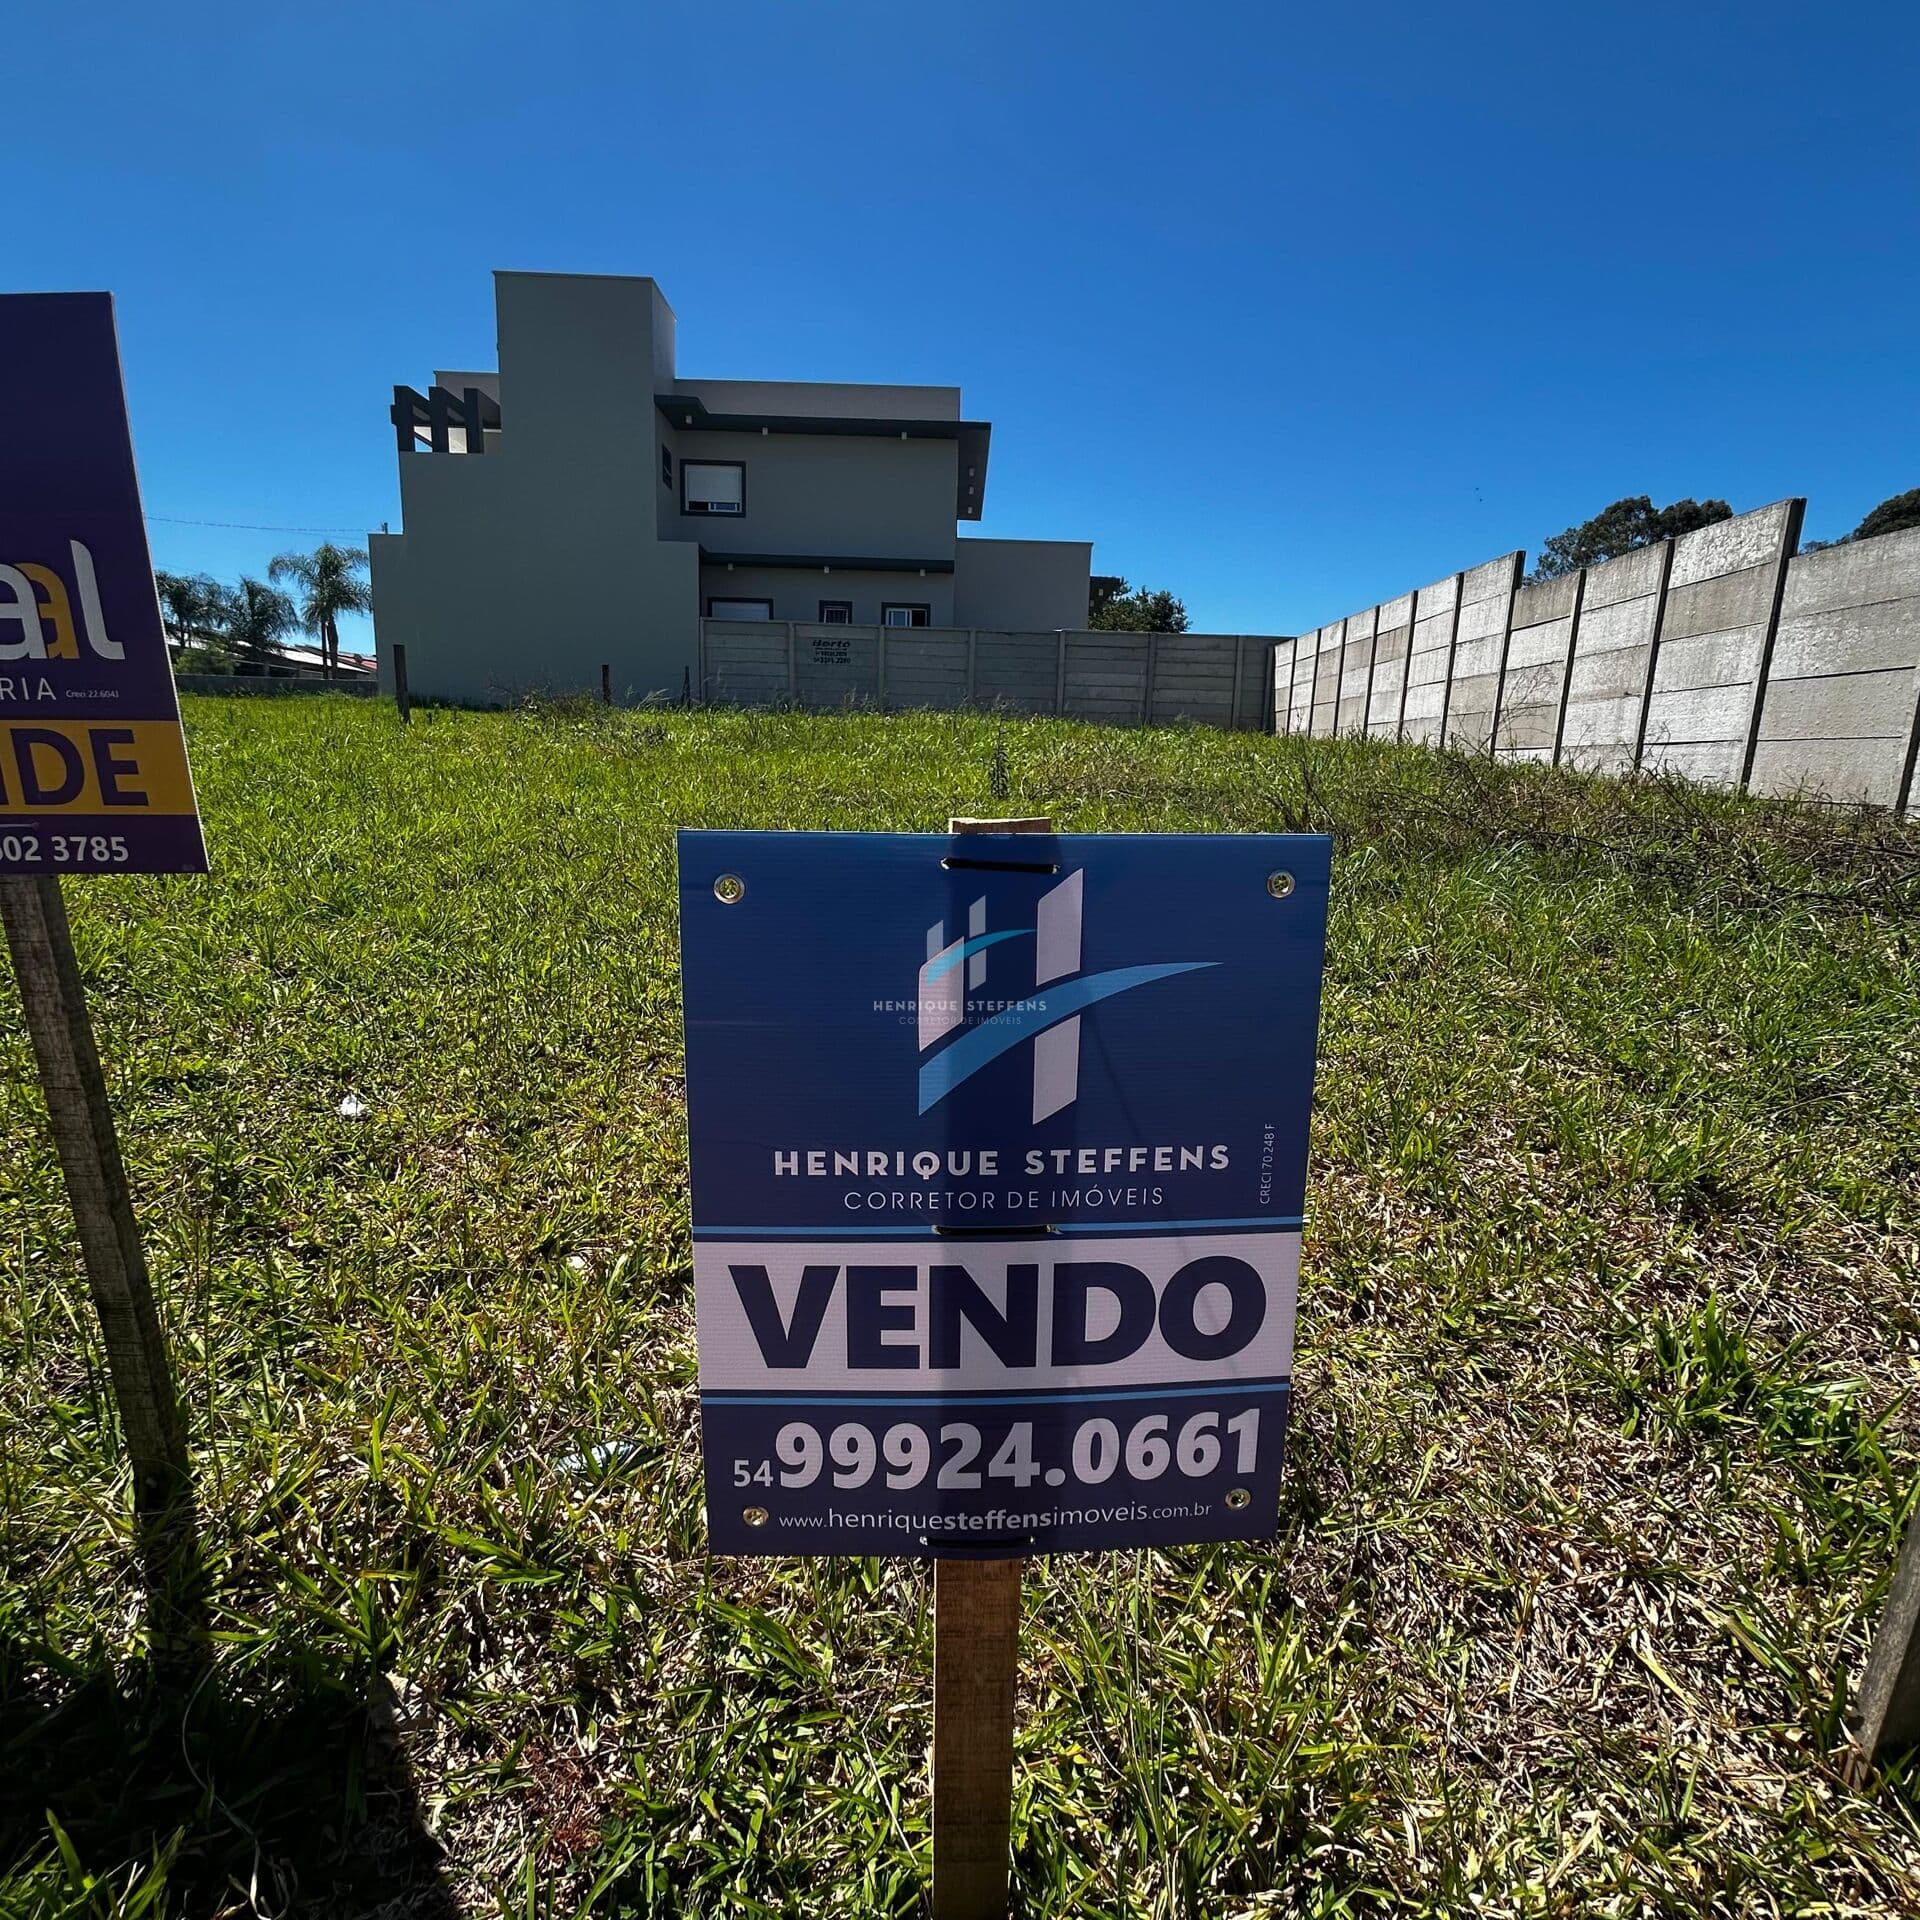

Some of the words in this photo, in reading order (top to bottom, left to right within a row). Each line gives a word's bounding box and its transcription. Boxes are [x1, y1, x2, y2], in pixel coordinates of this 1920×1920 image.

[0, 728, 149, 806] DE
[0, 835, 42, 862] 02
[51, 836, 129, 862] 3785
[774, 1150, 998, 1180] HENRIQUE
[1025, 1144, 1231, 1176] STEFFENS
[1261, 1132, 1275, 1169] 70.248
[843, 1190, 995, 1211] CORRETOR
[1006, 1189, 1039, 1209] DE
[1051, 1182, 1164, 1207] IMÓVEIS
[1259, 1172, 1272, 1204] CRECI
[728, 1255, 1267, 1369] VENDO
[733, 1459, 774, 1487] 54
[775, 1408, 1261, 1489] 99924.0661
[779, 1501, 1213, 1534] www.henriquesteffensimoveis.com.br
